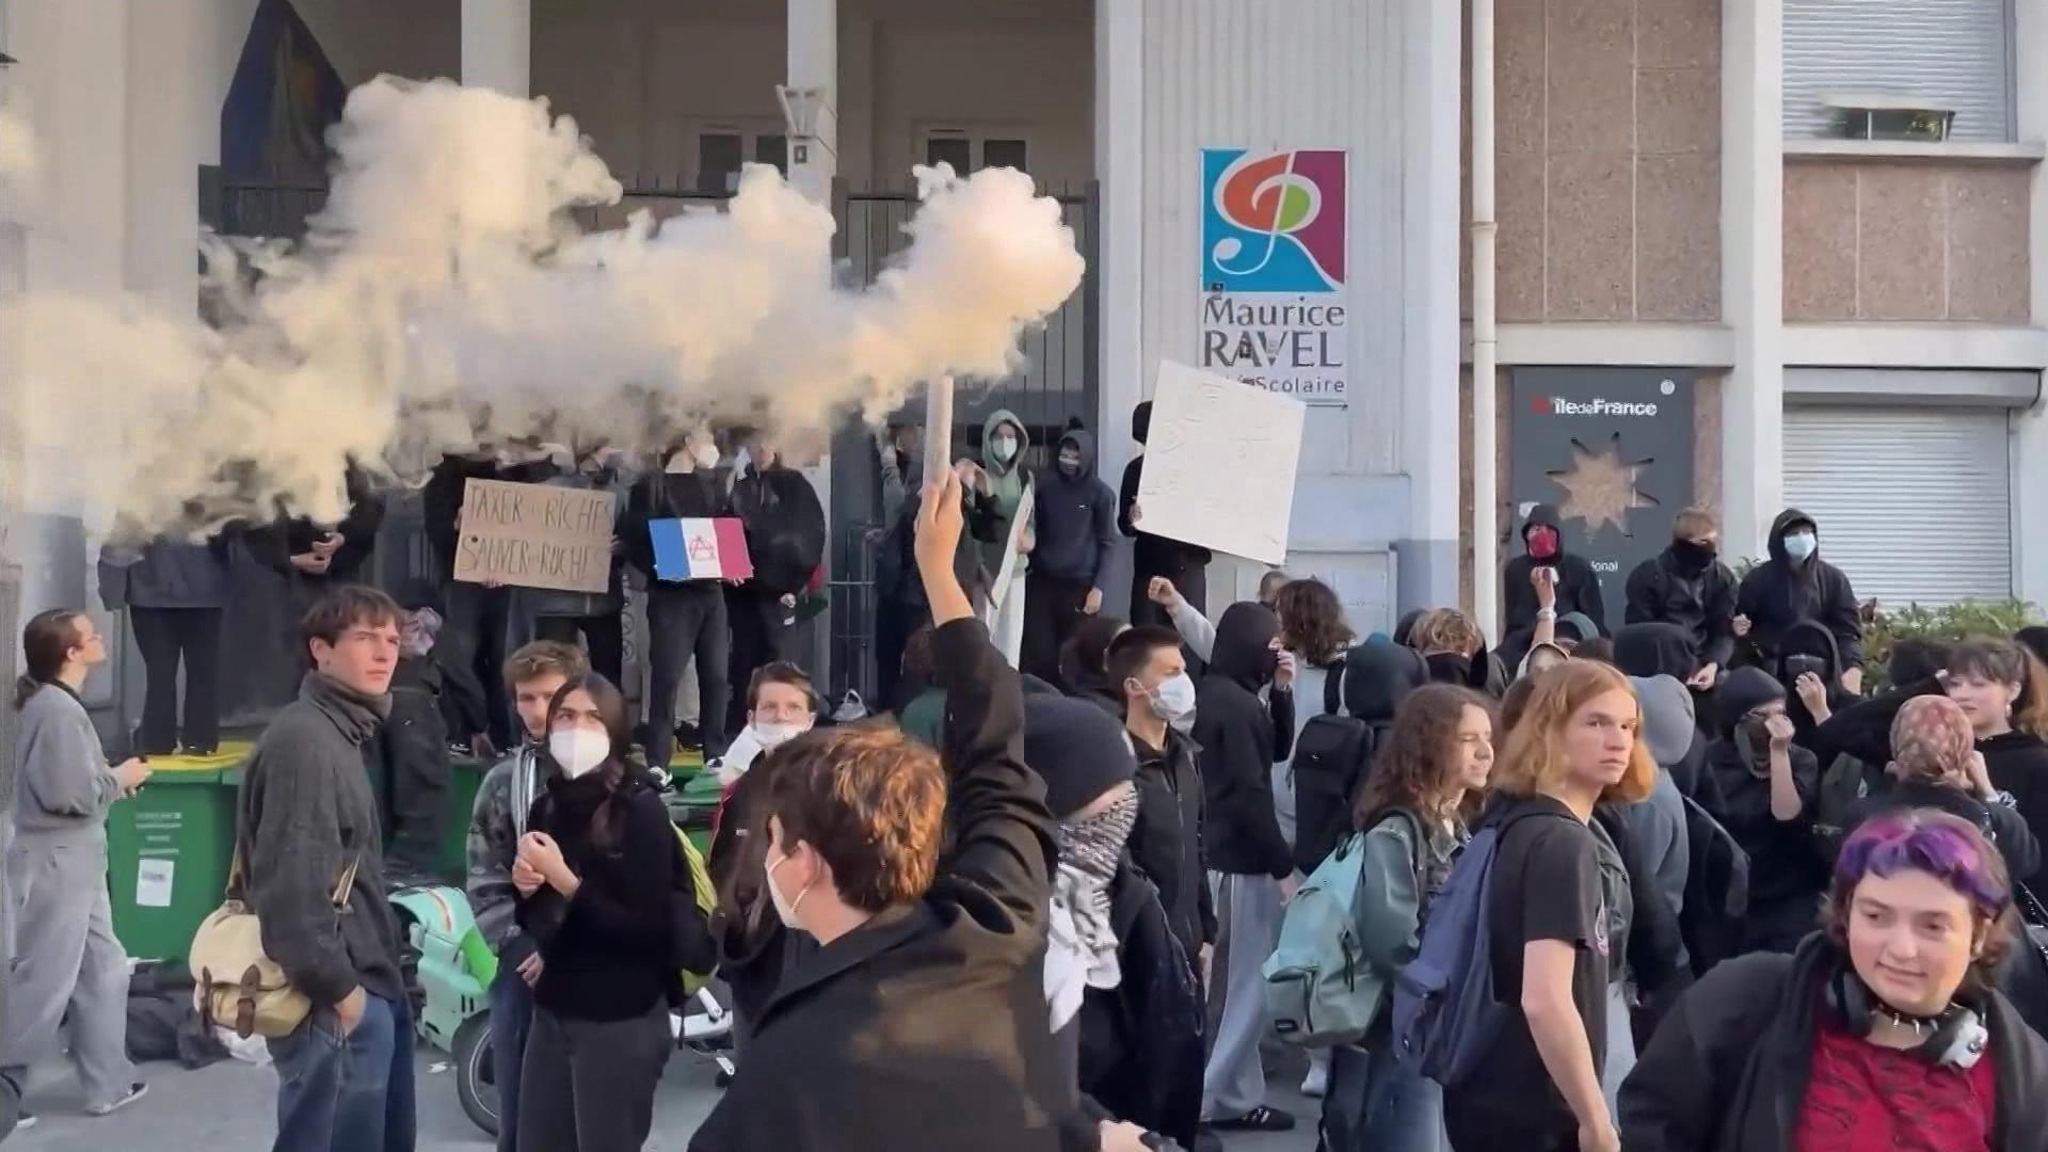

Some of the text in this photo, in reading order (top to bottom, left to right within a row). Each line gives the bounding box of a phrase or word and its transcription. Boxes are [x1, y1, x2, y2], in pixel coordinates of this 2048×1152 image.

[1203, 297, 1345, 326] Maurice
[1203, 330, 1343, 367] RAVEL
[470, 485, 524, 525] TAXER
[539, 540, 598, 582] RUCHE
